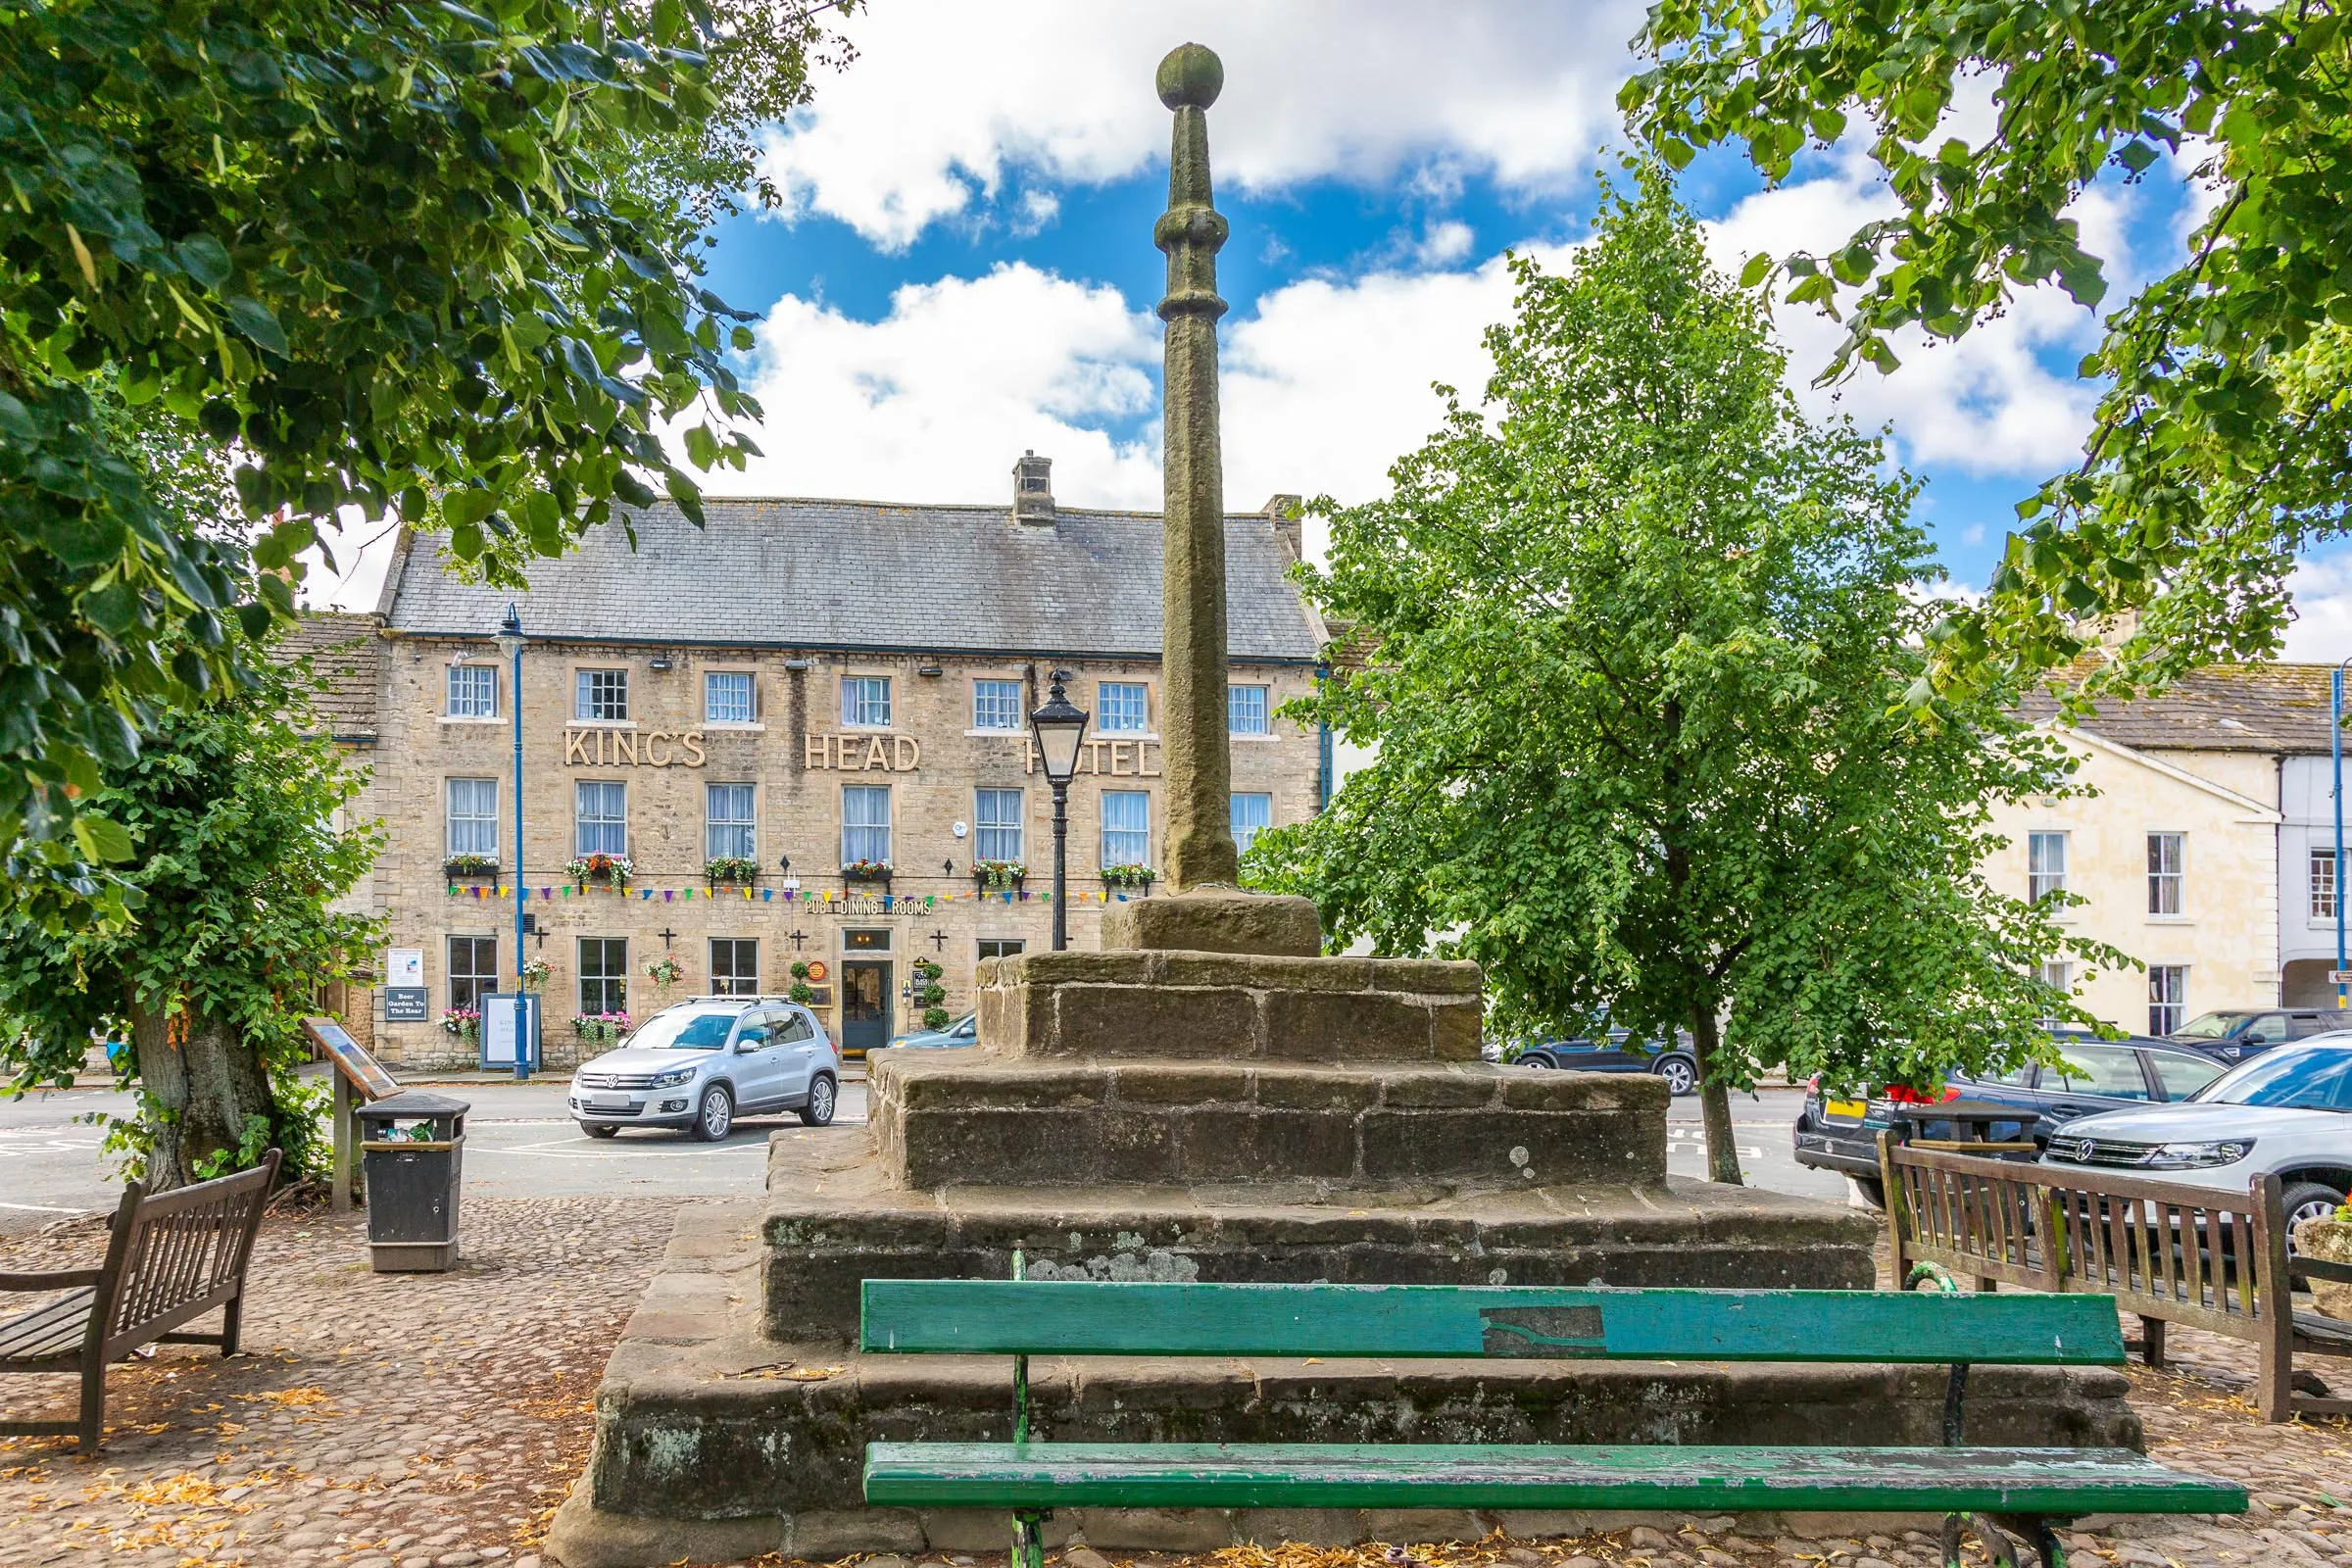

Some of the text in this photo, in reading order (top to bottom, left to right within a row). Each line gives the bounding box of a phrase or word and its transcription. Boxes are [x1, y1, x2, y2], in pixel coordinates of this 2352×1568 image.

[564, 729, 707, 767] KING'S
[805, 734, 920, 771] HEAD
[805, 901, 931, 915] PUB DINING ROOMS
